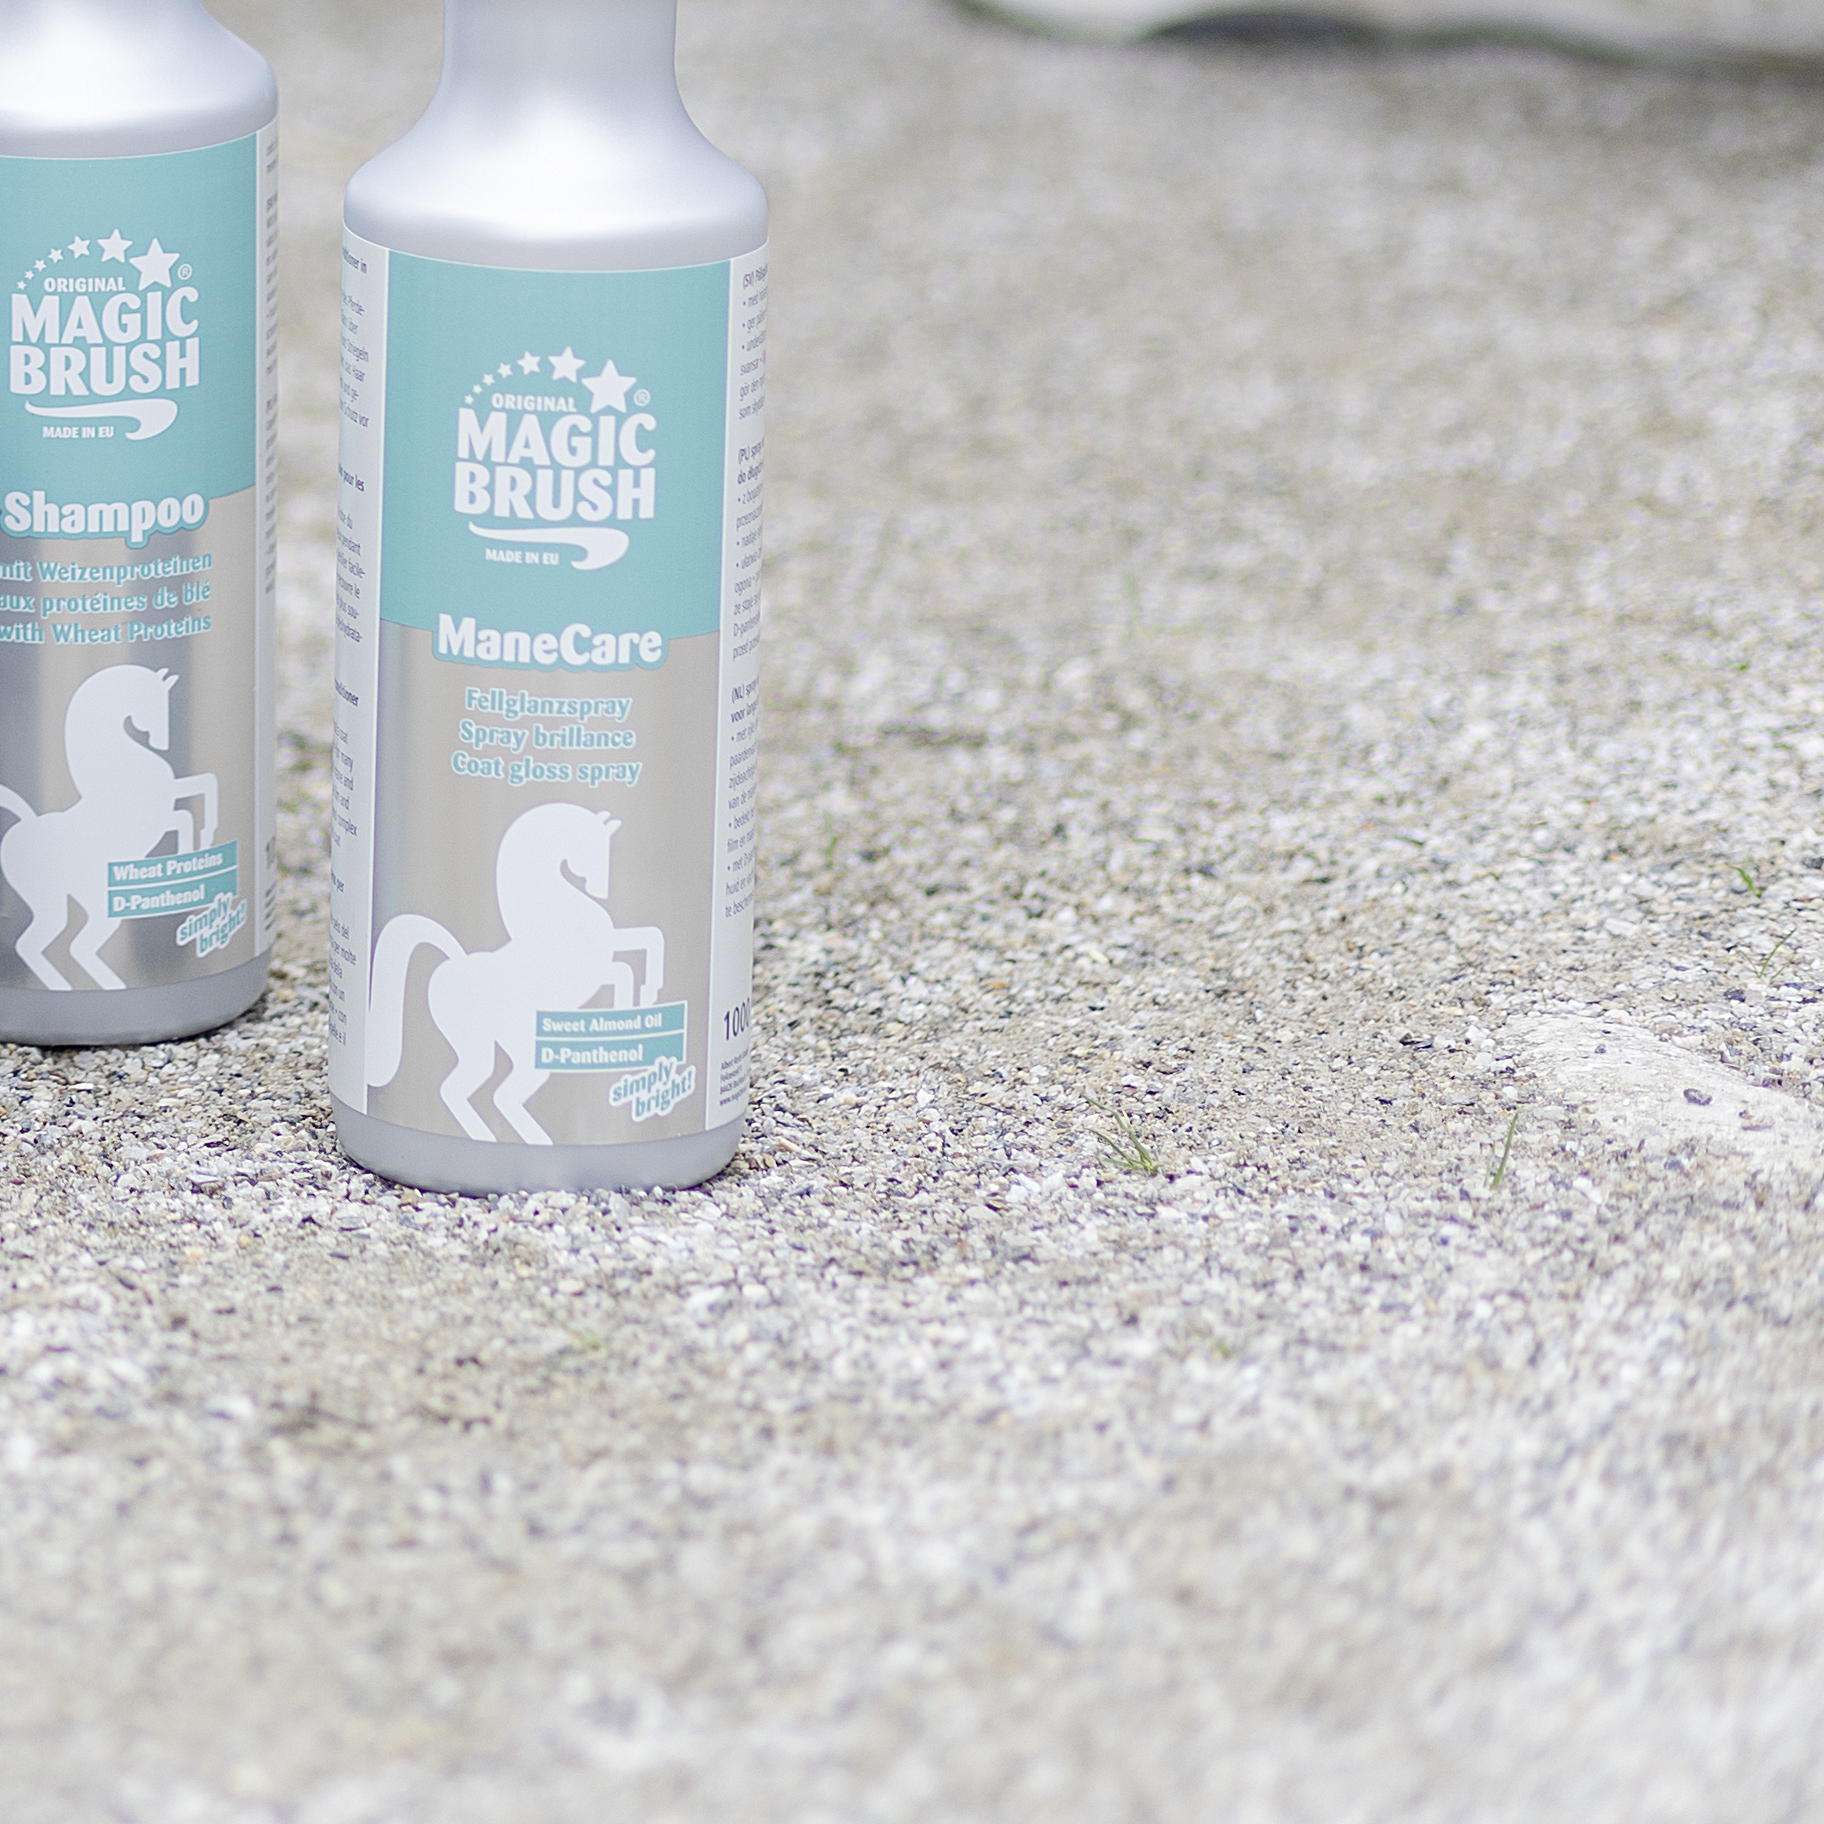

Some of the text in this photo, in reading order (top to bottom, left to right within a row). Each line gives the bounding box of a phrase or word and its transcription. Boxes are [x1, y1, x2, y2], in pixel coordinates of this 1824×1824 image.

[43, 277, 126, 292] ORIGINAL
[11, 286, 199, 344] MAGIC
[9, 337, 200, 396] BRUSH
[490, 392, 577, 412] ORIGINAL
[42, 426, 114, 439] MADE IN EU
[457, 407, 657, 467] MAGIC
[454, 461, 656, 522] BRUSH
[4, 490, 204, 543] Shampoo
[37, 553, 213, 587] Weizenproteinen
[485, 548, 559, 565] MADE IN EU
[41, 591, 147, 618] protéines
[153, 586, 178, 609] de
[183, 579, 211, 605] blé
[51, 622, 122, 645] Wheat
[128, 614, 212, 642] Proteins
[438, 612, 662, 666] ManeCare
[465, 687, 633, 722] Fellglanzspray
[459, 718, 636, 753] Spray brillance
[451, 750, 643, 788] Coat gloss spray
[113, 853, 223, 881] Wheat Proteins
[113, 883, 205, 912] D-Panthenol
[178, 896, 231, 943] simply
[199, 900, 247, 955] bright!
[542, 1013, 663, 1033] Sweet Almond Oil
[541, 1044, 644, 1064] D-Panthenol
[612, 1060, 674, 1103] simply
[635, 1068, 693, 1118] bright!
